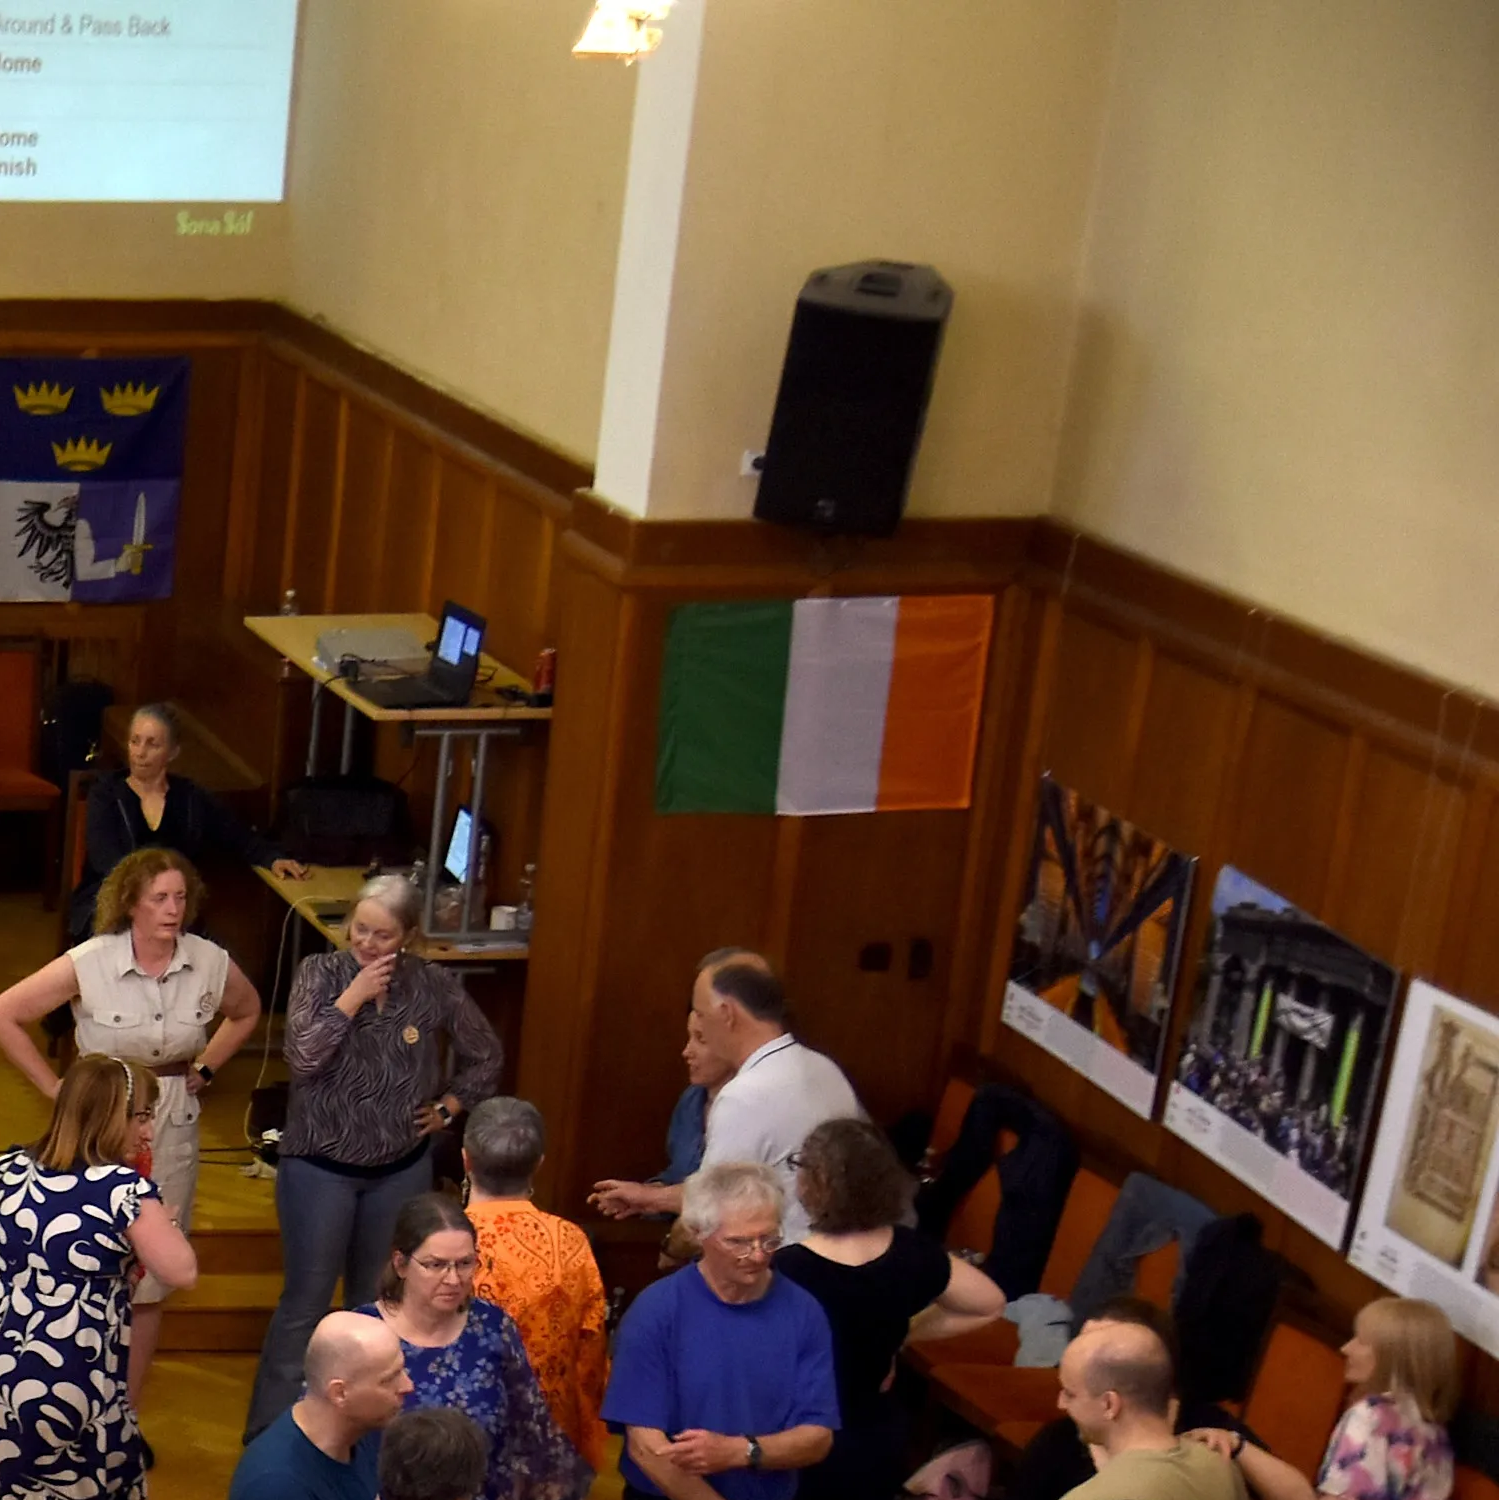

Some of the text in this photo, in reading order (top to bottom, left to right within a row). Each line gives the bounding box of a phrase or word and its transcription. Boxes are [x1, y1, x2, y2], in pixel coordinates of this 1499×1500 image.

[60, 14, 73, 35] &
[79, 14, 123, 36] Pass
[128, 15, 171, 37] Back
